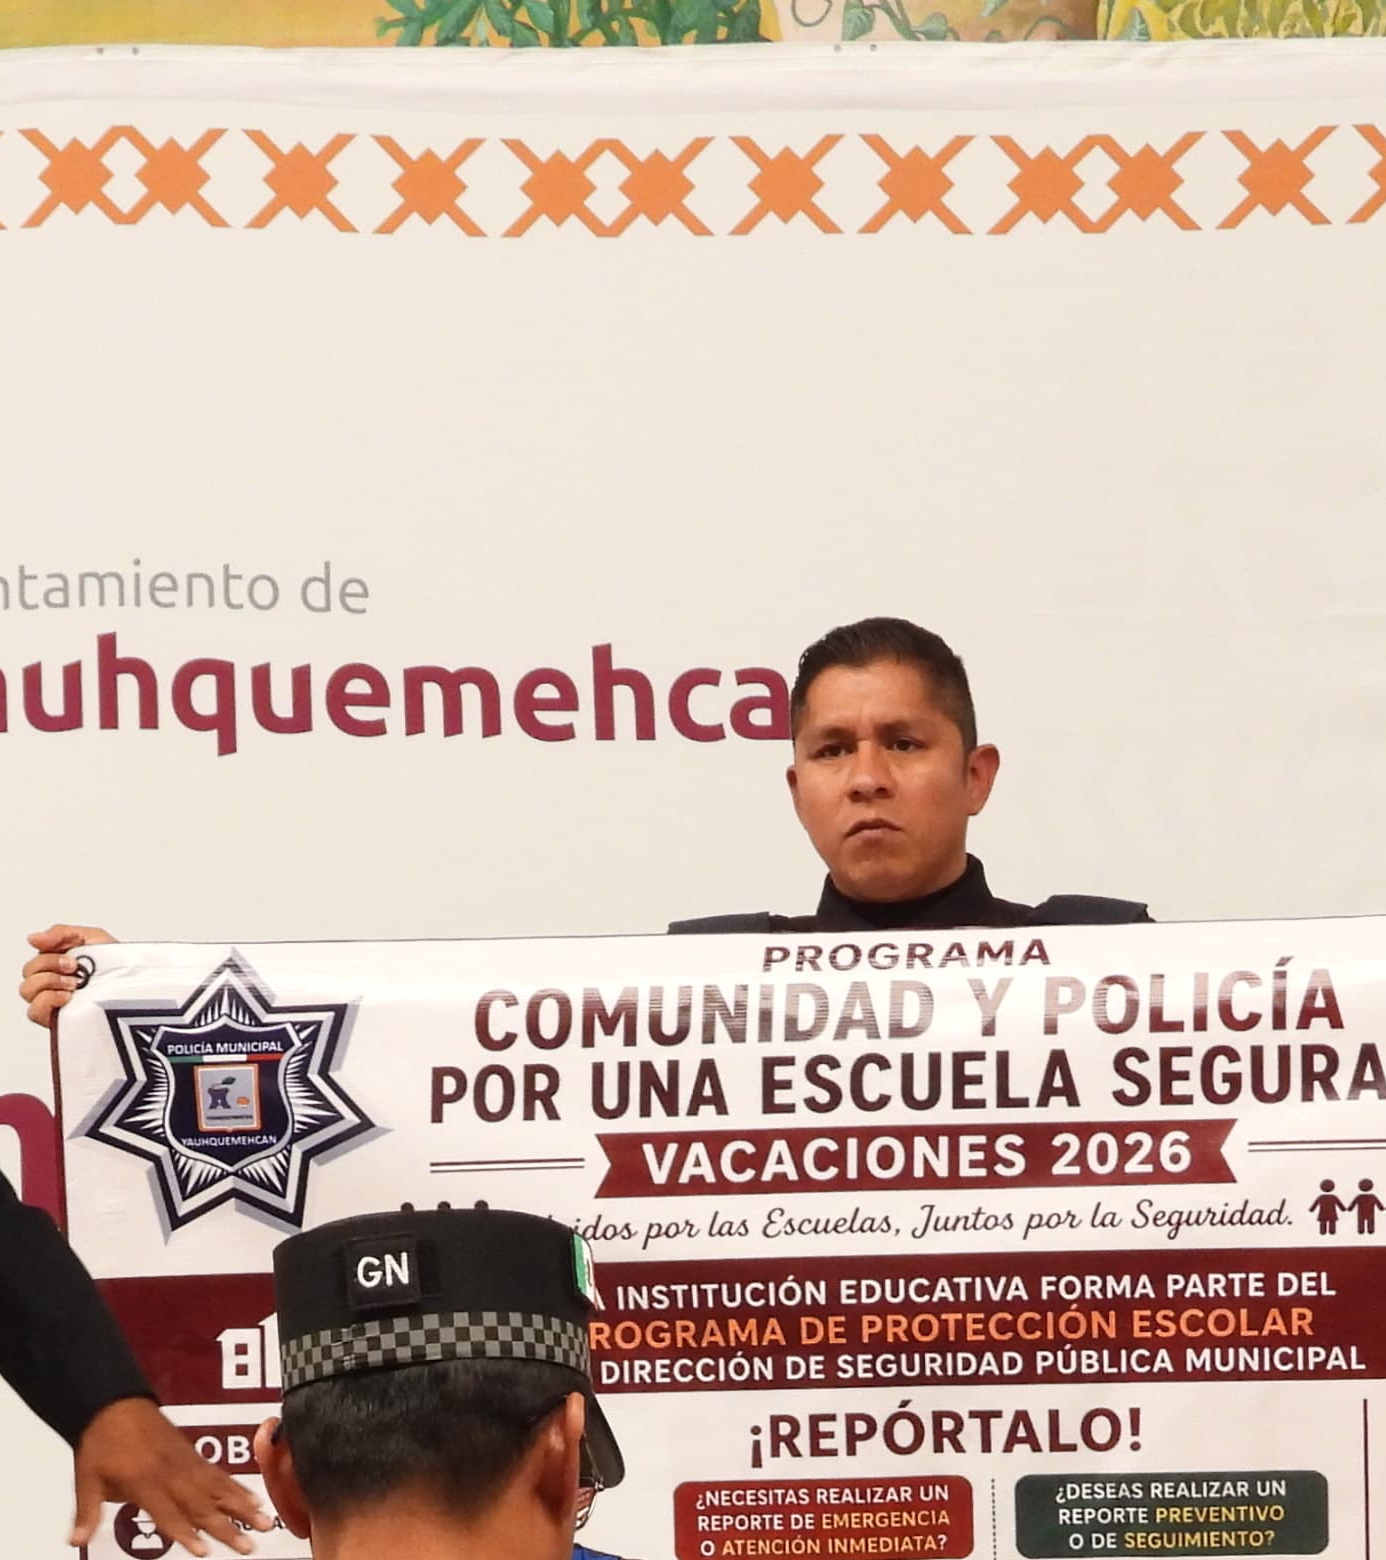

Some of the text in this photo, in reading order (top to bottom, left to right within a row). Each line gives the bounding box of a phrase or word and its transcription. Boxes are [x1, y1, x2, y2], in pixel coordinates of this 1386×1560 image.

[299, 560, 371, 615] de
[761, 937, 1051, 973] PROGRAMA
[474, 956, 1345, 1052] COMUNIDAD Y POLICÍA
[167, 1040, 284, 1055] POLICÍA MUNICIPAL
[430, 1060, 562, 1124] POR
[591, 1057, 729, 1120] UNA
[761, 1046, 1080, 1115] ESCUELA
[181, 1135, 278, 1147] YAUHQUEMEHCAN
[642, 1131, 1193, 1185] VACACIONES 2026
[641, 1217, 700, 1250] por
[707, 1210, 750, 1238] las
[762, 1207, 902, 1239] Escuelas,
[911, 1204, 1015, 1240] Juntos
[1023, 1209, 1084, 1241] por
[1090, 1201, 1124, 1230] la
[1130, 1198, 1294, 1241] Seguridad.
[356, 1251, 410, 1289] GN
[616, 1274, 827, 1311] INSTITUCIÓN
[840, 1275, 1029, 1306] EDUCATIVA
[1040, 1273, 1156, 1301] FORMA
[1166, 1272, 1265, 1299] PARTE
[1276, 1271, 1337, 1298] DEL
[589, 1303, 1314, 1351] ROGRAMA DE PROTECCIÓN ESCOLAR
[600, 1342, 1367, 1385] DIRECCIÓN DE SEGURIDAD PÚBLICA MUNICIPAL
[748, 1400, 1143, 1470] ¡REPÓRTALO!
[695, 1485, 950, 1511] ¿NECESITAS REALIZAR UN
[1054, 1480, 1287, 1504] ¿DESEAS REALIZAR UN
[697, 1509, 951, 1532] REPORTE DE EMERGENCIA
[1058, 1505, 1286, 1525] REPORTE PREVENTIVO
[700, 1534, 948, 1557] O ATENCIÓN INMEDIATA?
[1068, 1530, 1276, 1550] O DE SEGUIMIENTO?
